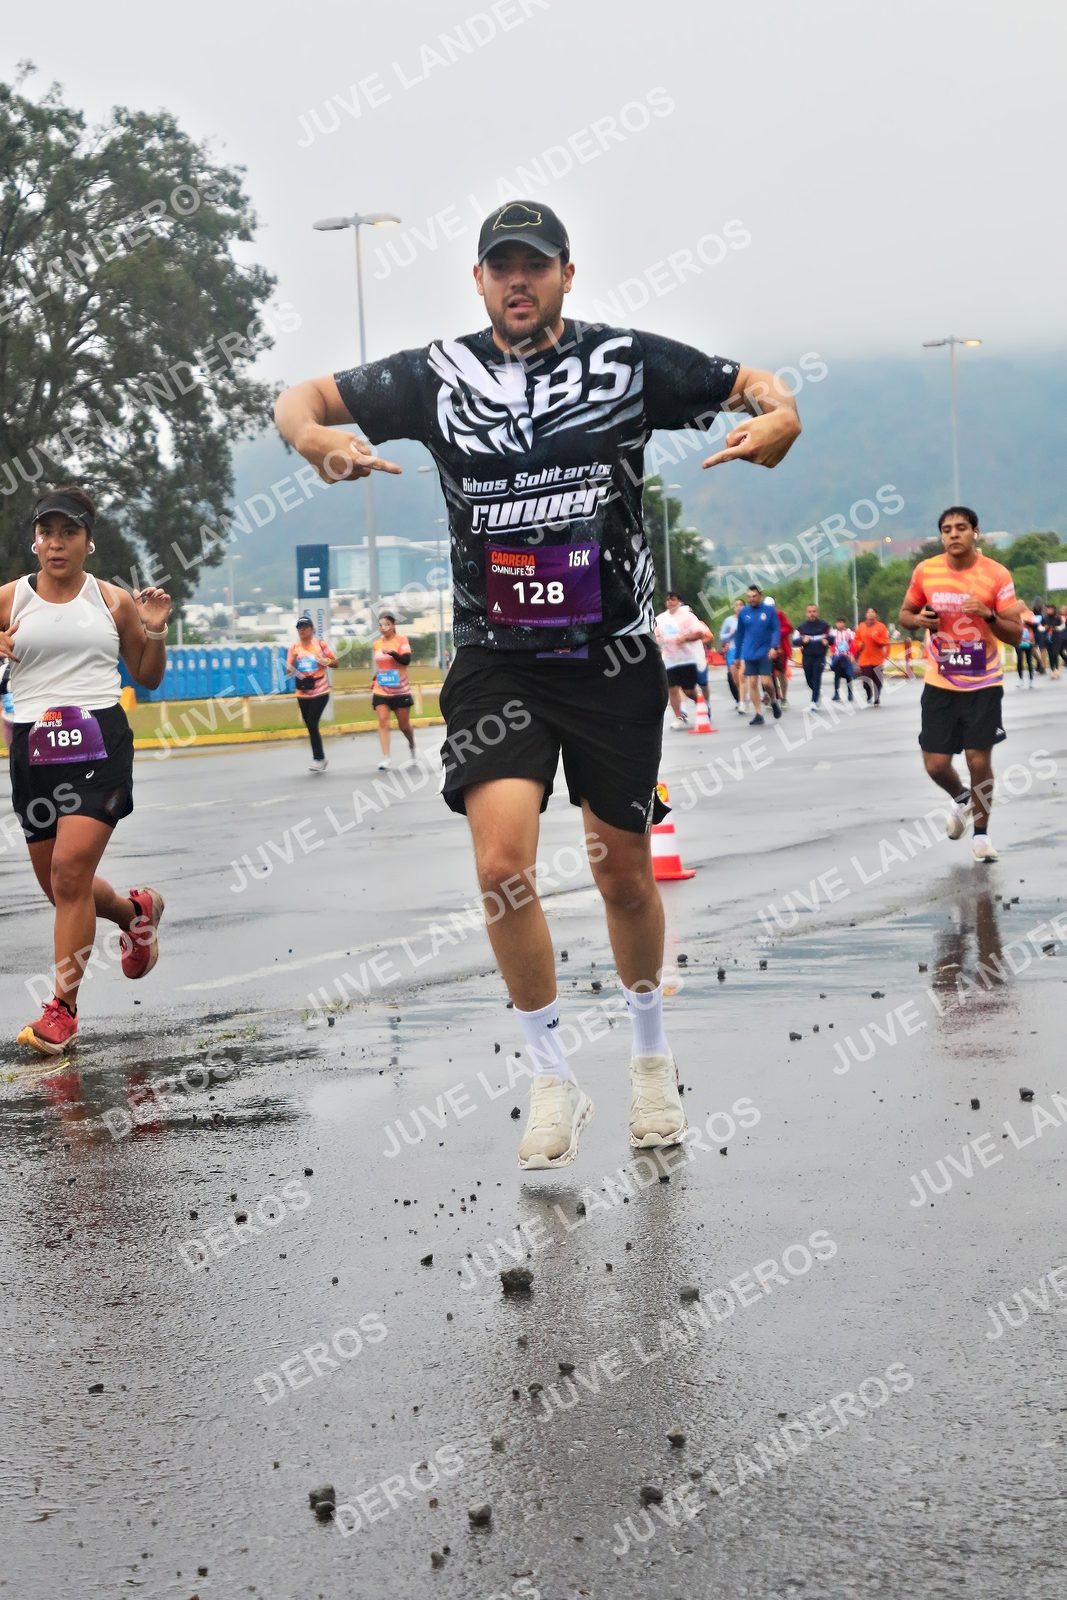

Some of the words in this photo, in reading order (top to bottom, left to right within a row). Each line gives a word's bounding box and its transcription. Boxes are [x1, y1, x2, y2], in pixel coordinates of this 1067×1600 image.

[491, 551, 536, 567] CARRERA
[569, 550, 590, 568] 15K
[303, 567, 321, 592] E
[512, 581, 565, 605] 128
[948, 653, 972, 666] 445
[46, 728, 83, 748] 189
